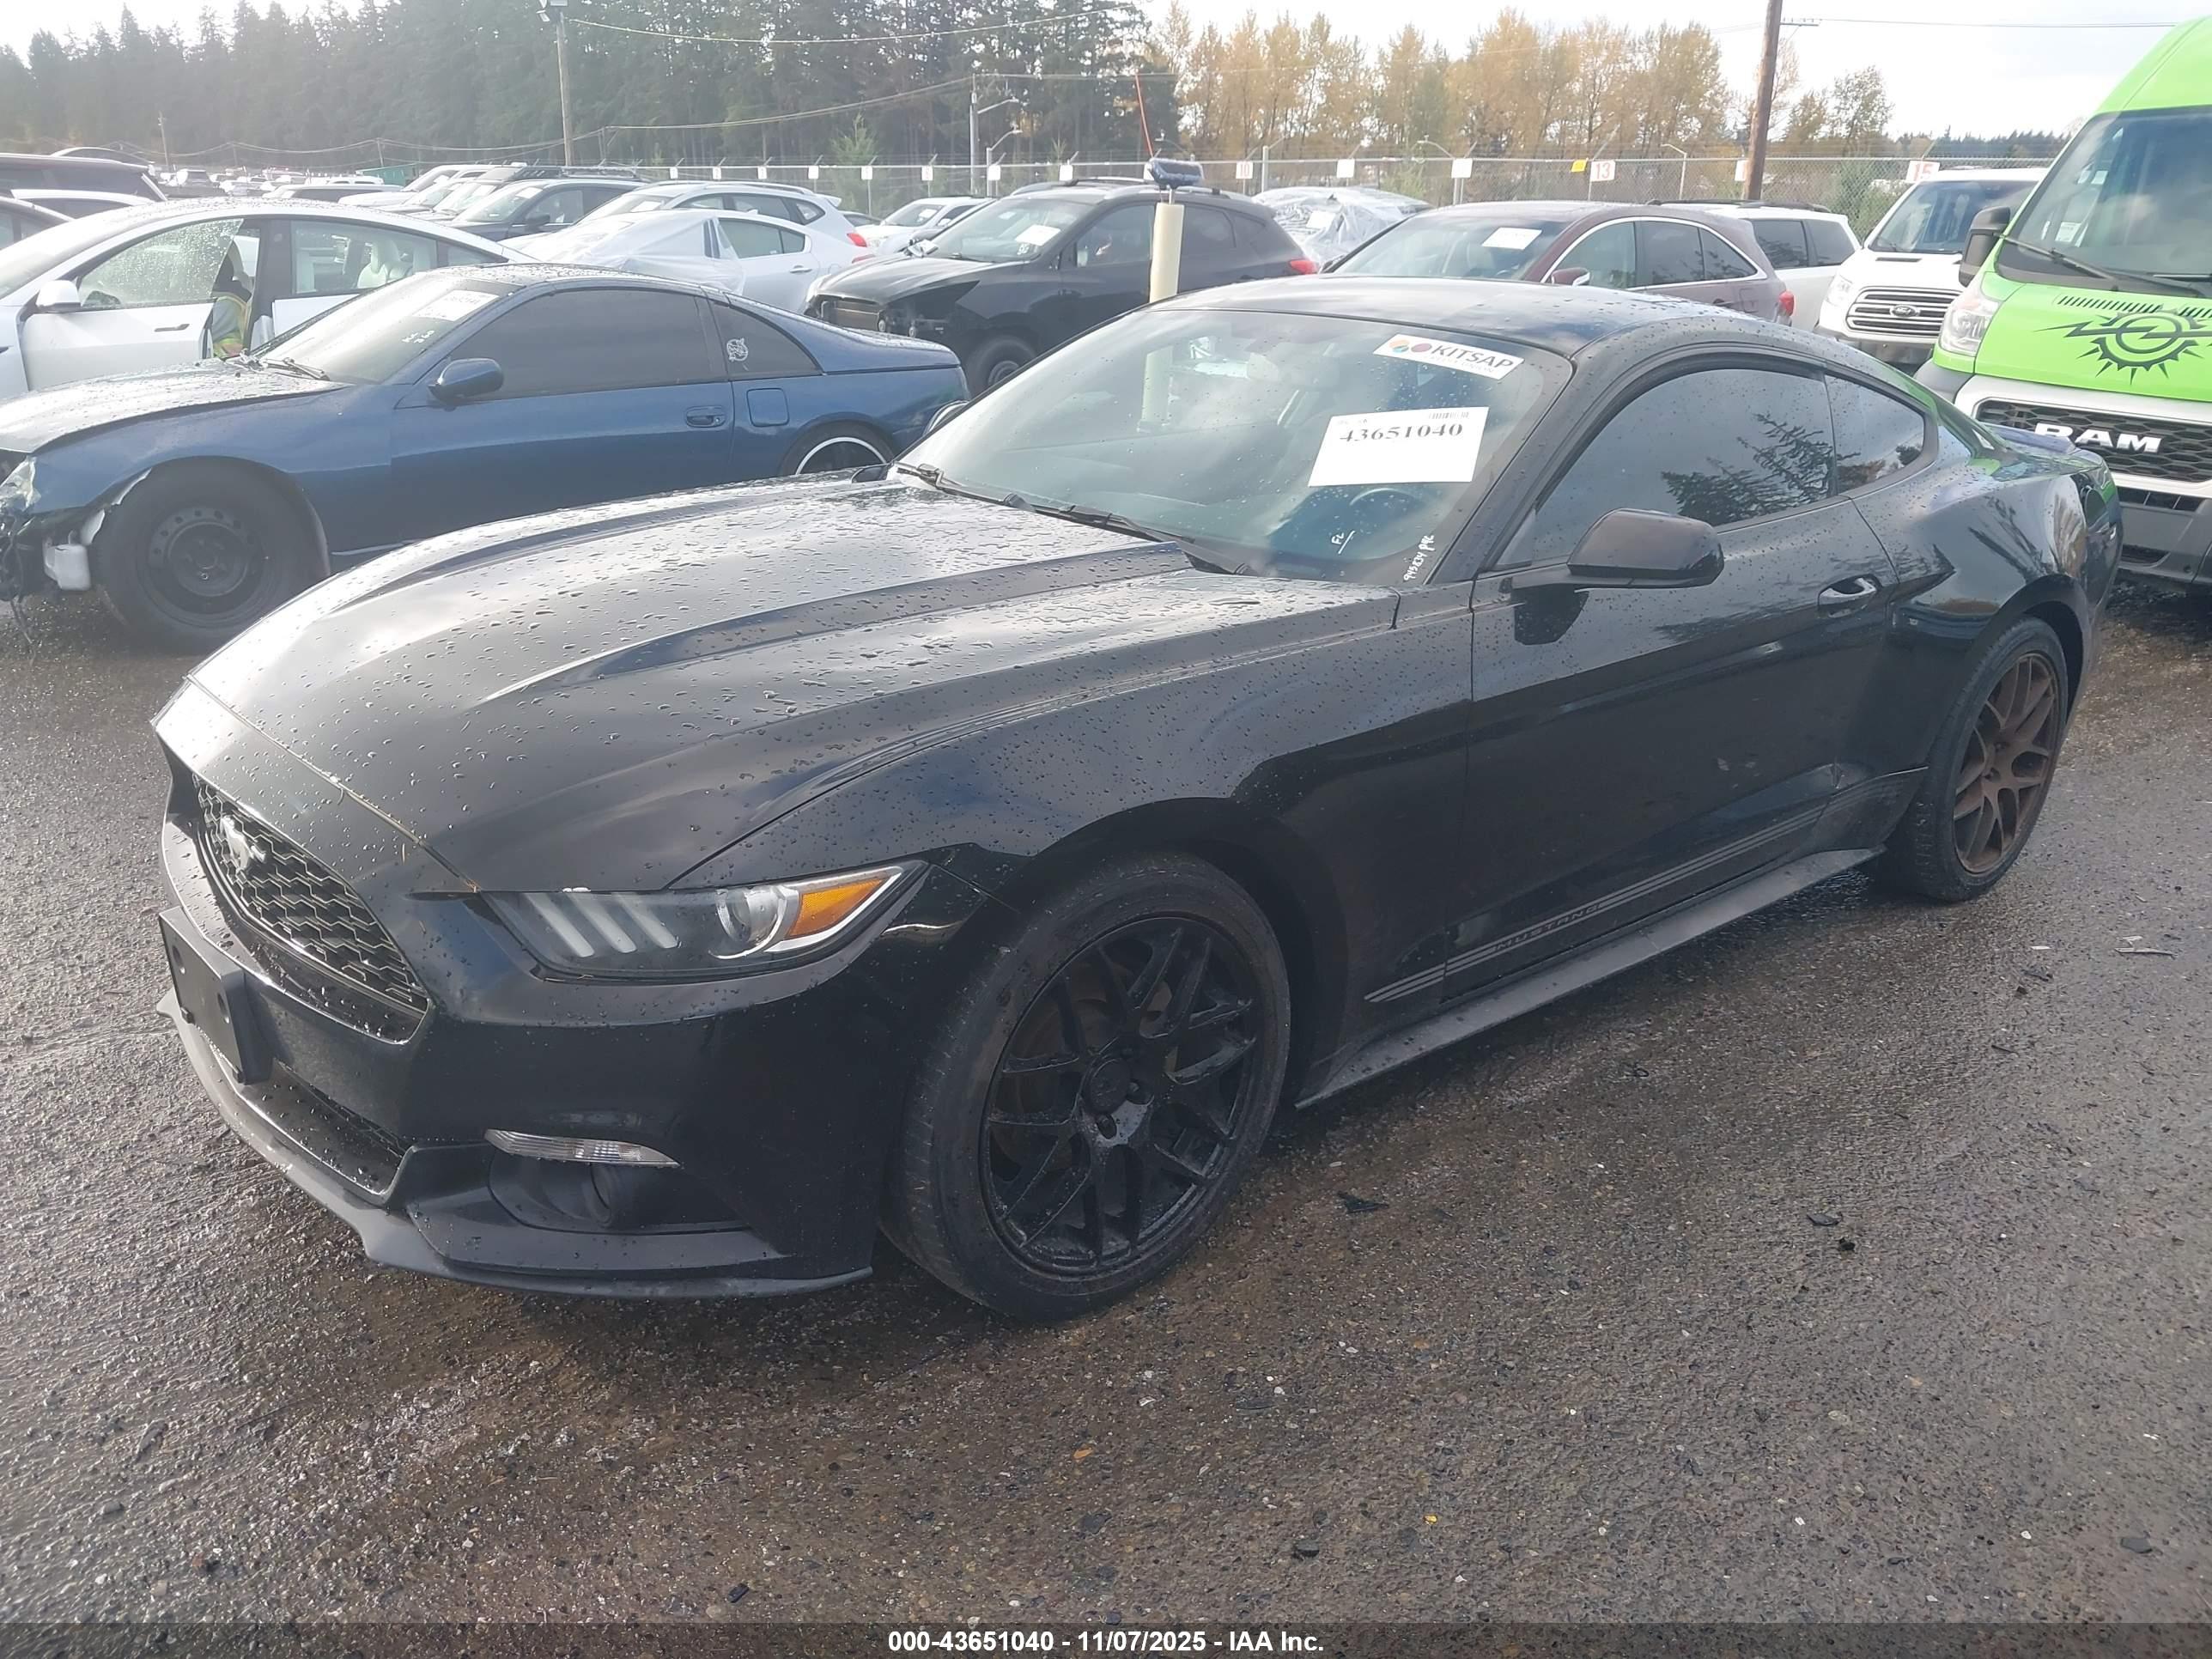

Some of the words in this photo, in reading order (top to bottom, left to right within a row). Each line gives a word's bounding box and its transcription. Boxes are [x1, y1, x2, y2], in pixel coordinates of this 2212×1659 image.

[1240, 164, 1250, 177] 10
[1596, 162, 1611, 179] 13
[1431, 345, 1513, 368] KITSAP
[1340, 423, 1463, 442] 43651040
[2034, 422, 2161, 453] RAM
[1497, 906, 1599, 951] MUSTANG
